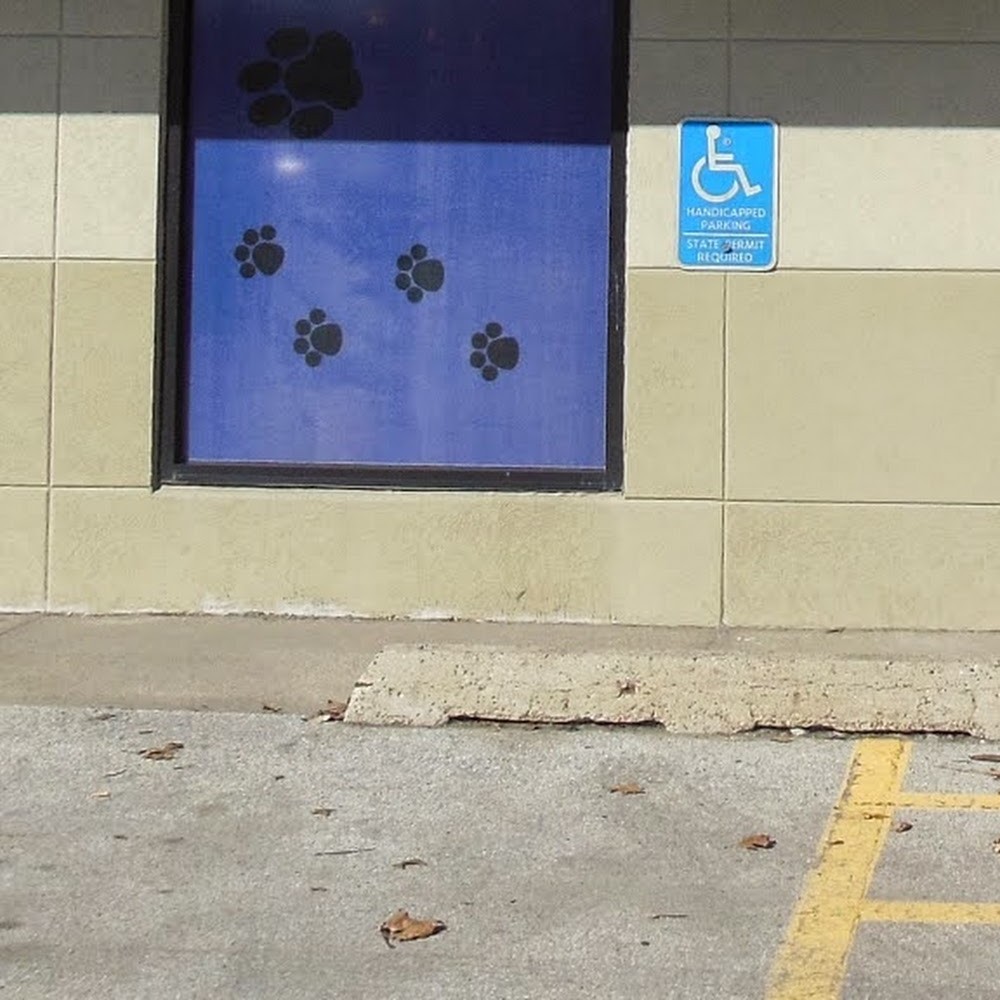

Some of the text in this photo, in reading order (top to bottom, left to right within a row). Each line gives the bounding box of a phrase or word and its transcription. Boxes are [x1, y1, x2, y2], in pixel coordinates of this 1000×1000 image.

[686, 207, 766, 218] HANDICAPPED
[700, 220, 751, 231] PARKING
[687, 239, 719, 250] STATE
[697, 252, 753, 263] REQUIRED
